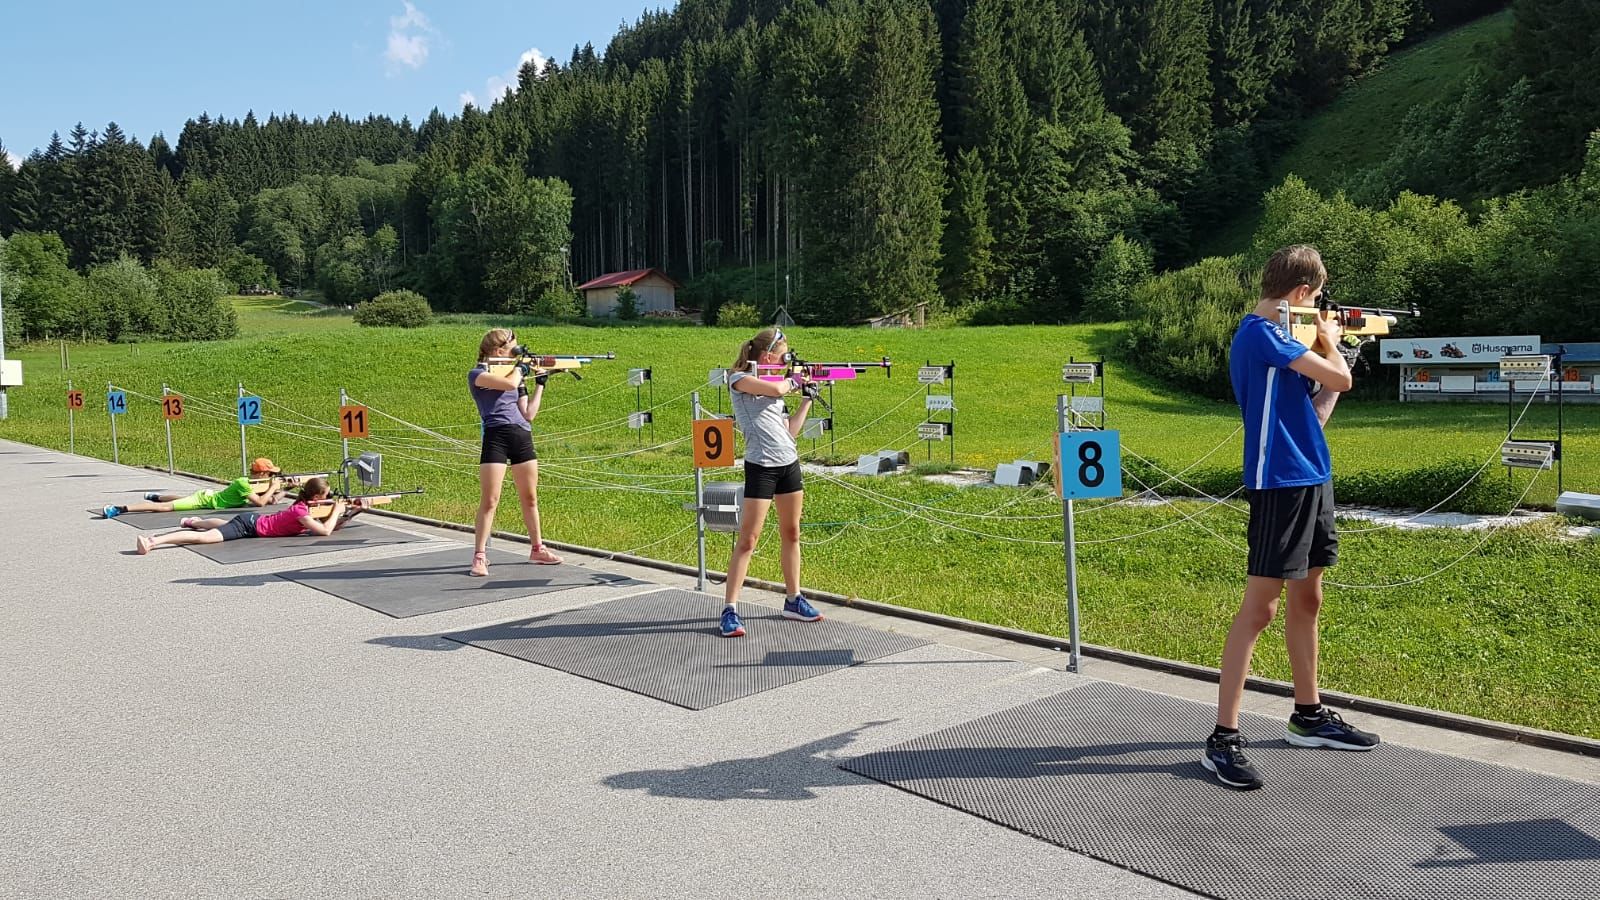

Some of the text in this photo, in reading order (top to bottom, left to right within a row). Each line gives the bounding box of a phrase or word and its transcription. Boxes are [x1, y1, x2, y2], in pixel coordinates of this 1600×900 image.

[1488, 370, 1499, 381] 14
[68, 393, 82, 406] 15
[109, 395, 125, 410] 14
[163, 399, 181, 415] 13
[240, 401, 259, 420] 12
[343, 410, 363, 432] 11
[704, 426, 722, 460] 9
[1078, 441, 1104, 488] 8
